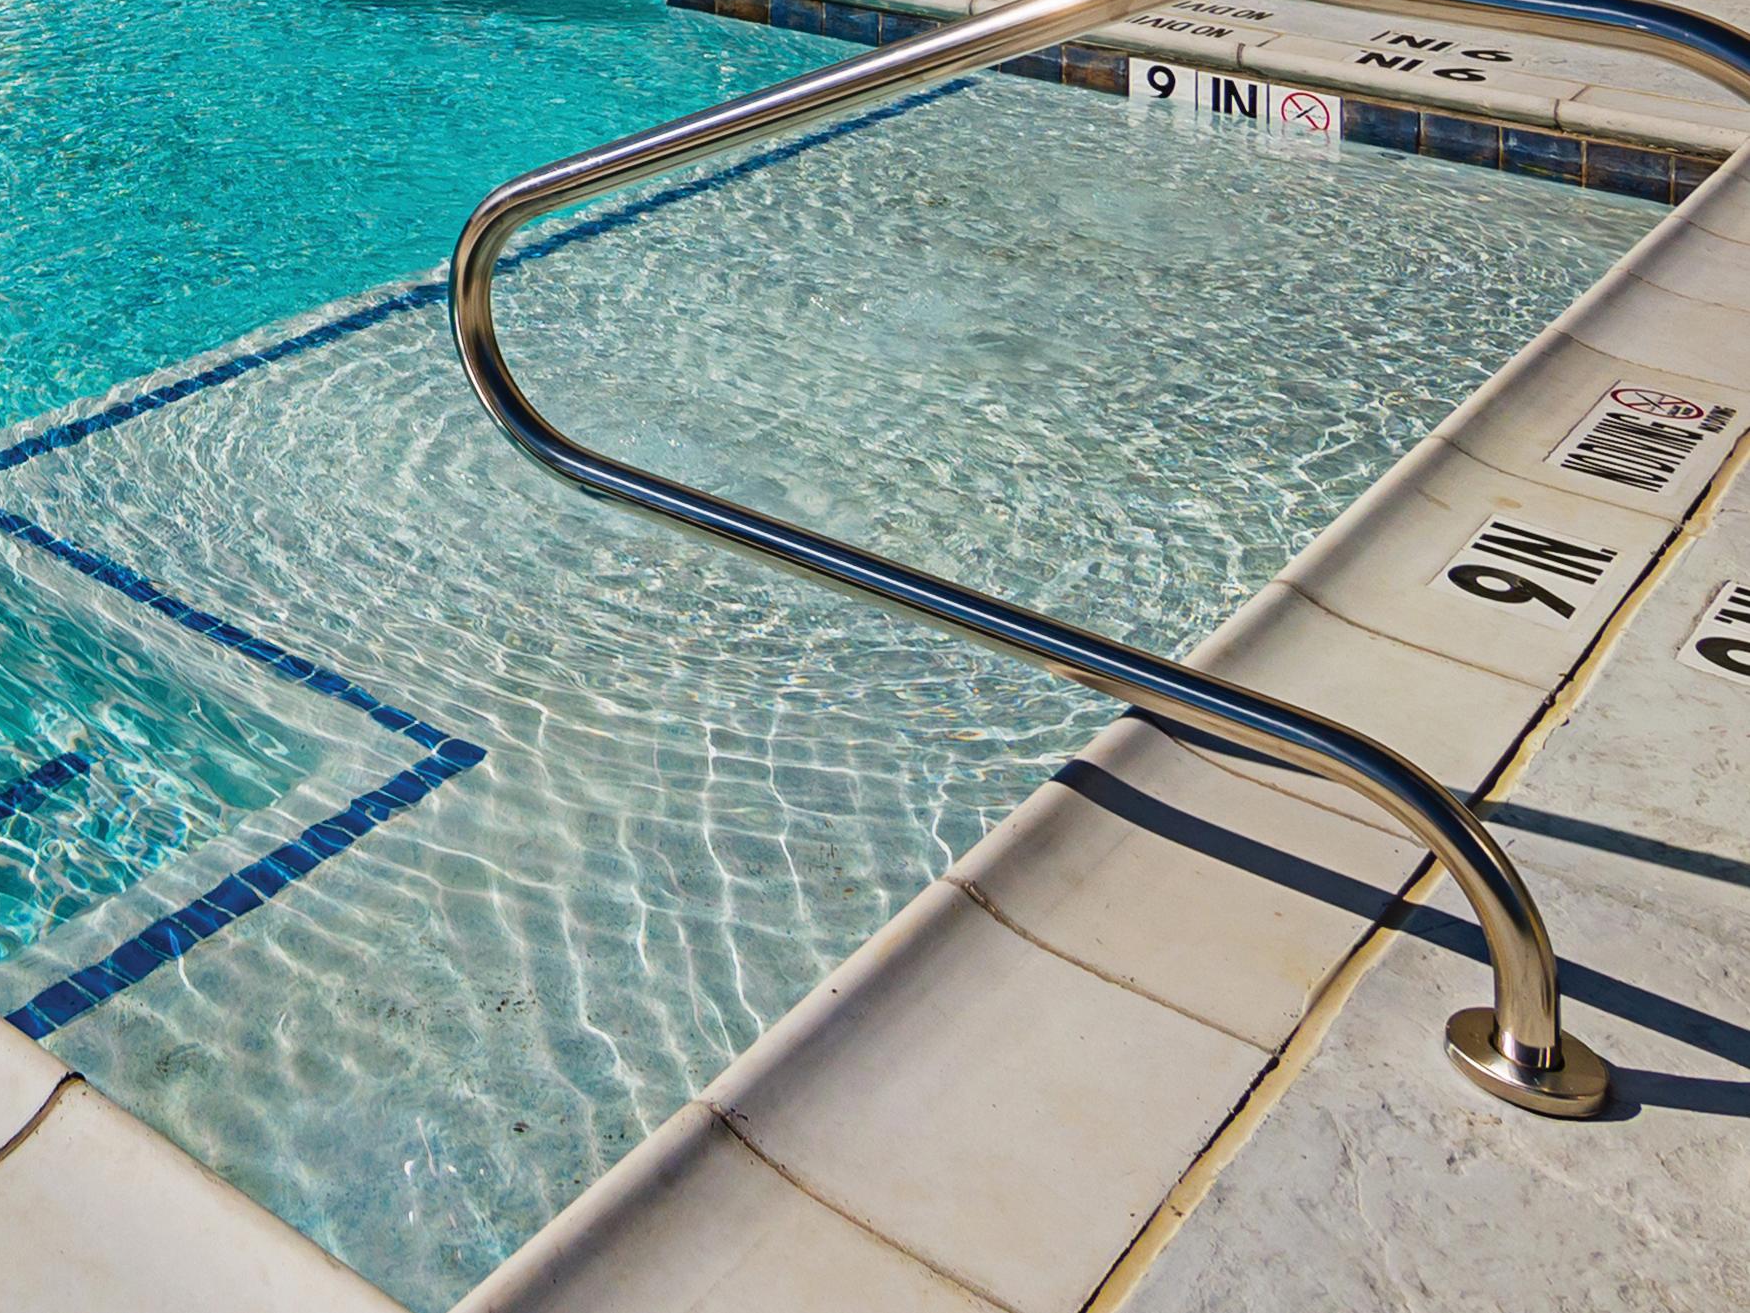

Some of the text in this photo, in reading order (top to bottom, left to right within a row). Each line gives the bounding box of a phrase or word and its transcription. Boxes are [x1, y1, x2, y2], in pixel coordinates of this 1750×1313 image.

[1125, 15, 1234, 38] NO DIVI
[1172, 0, 1274, 21] NO DIVI
[1147, 65, 1258, 119] 9 IN
[1560, 412, 1704, 493] NO DIVING
[1447, 521, 1618, 620] 9 IN.
